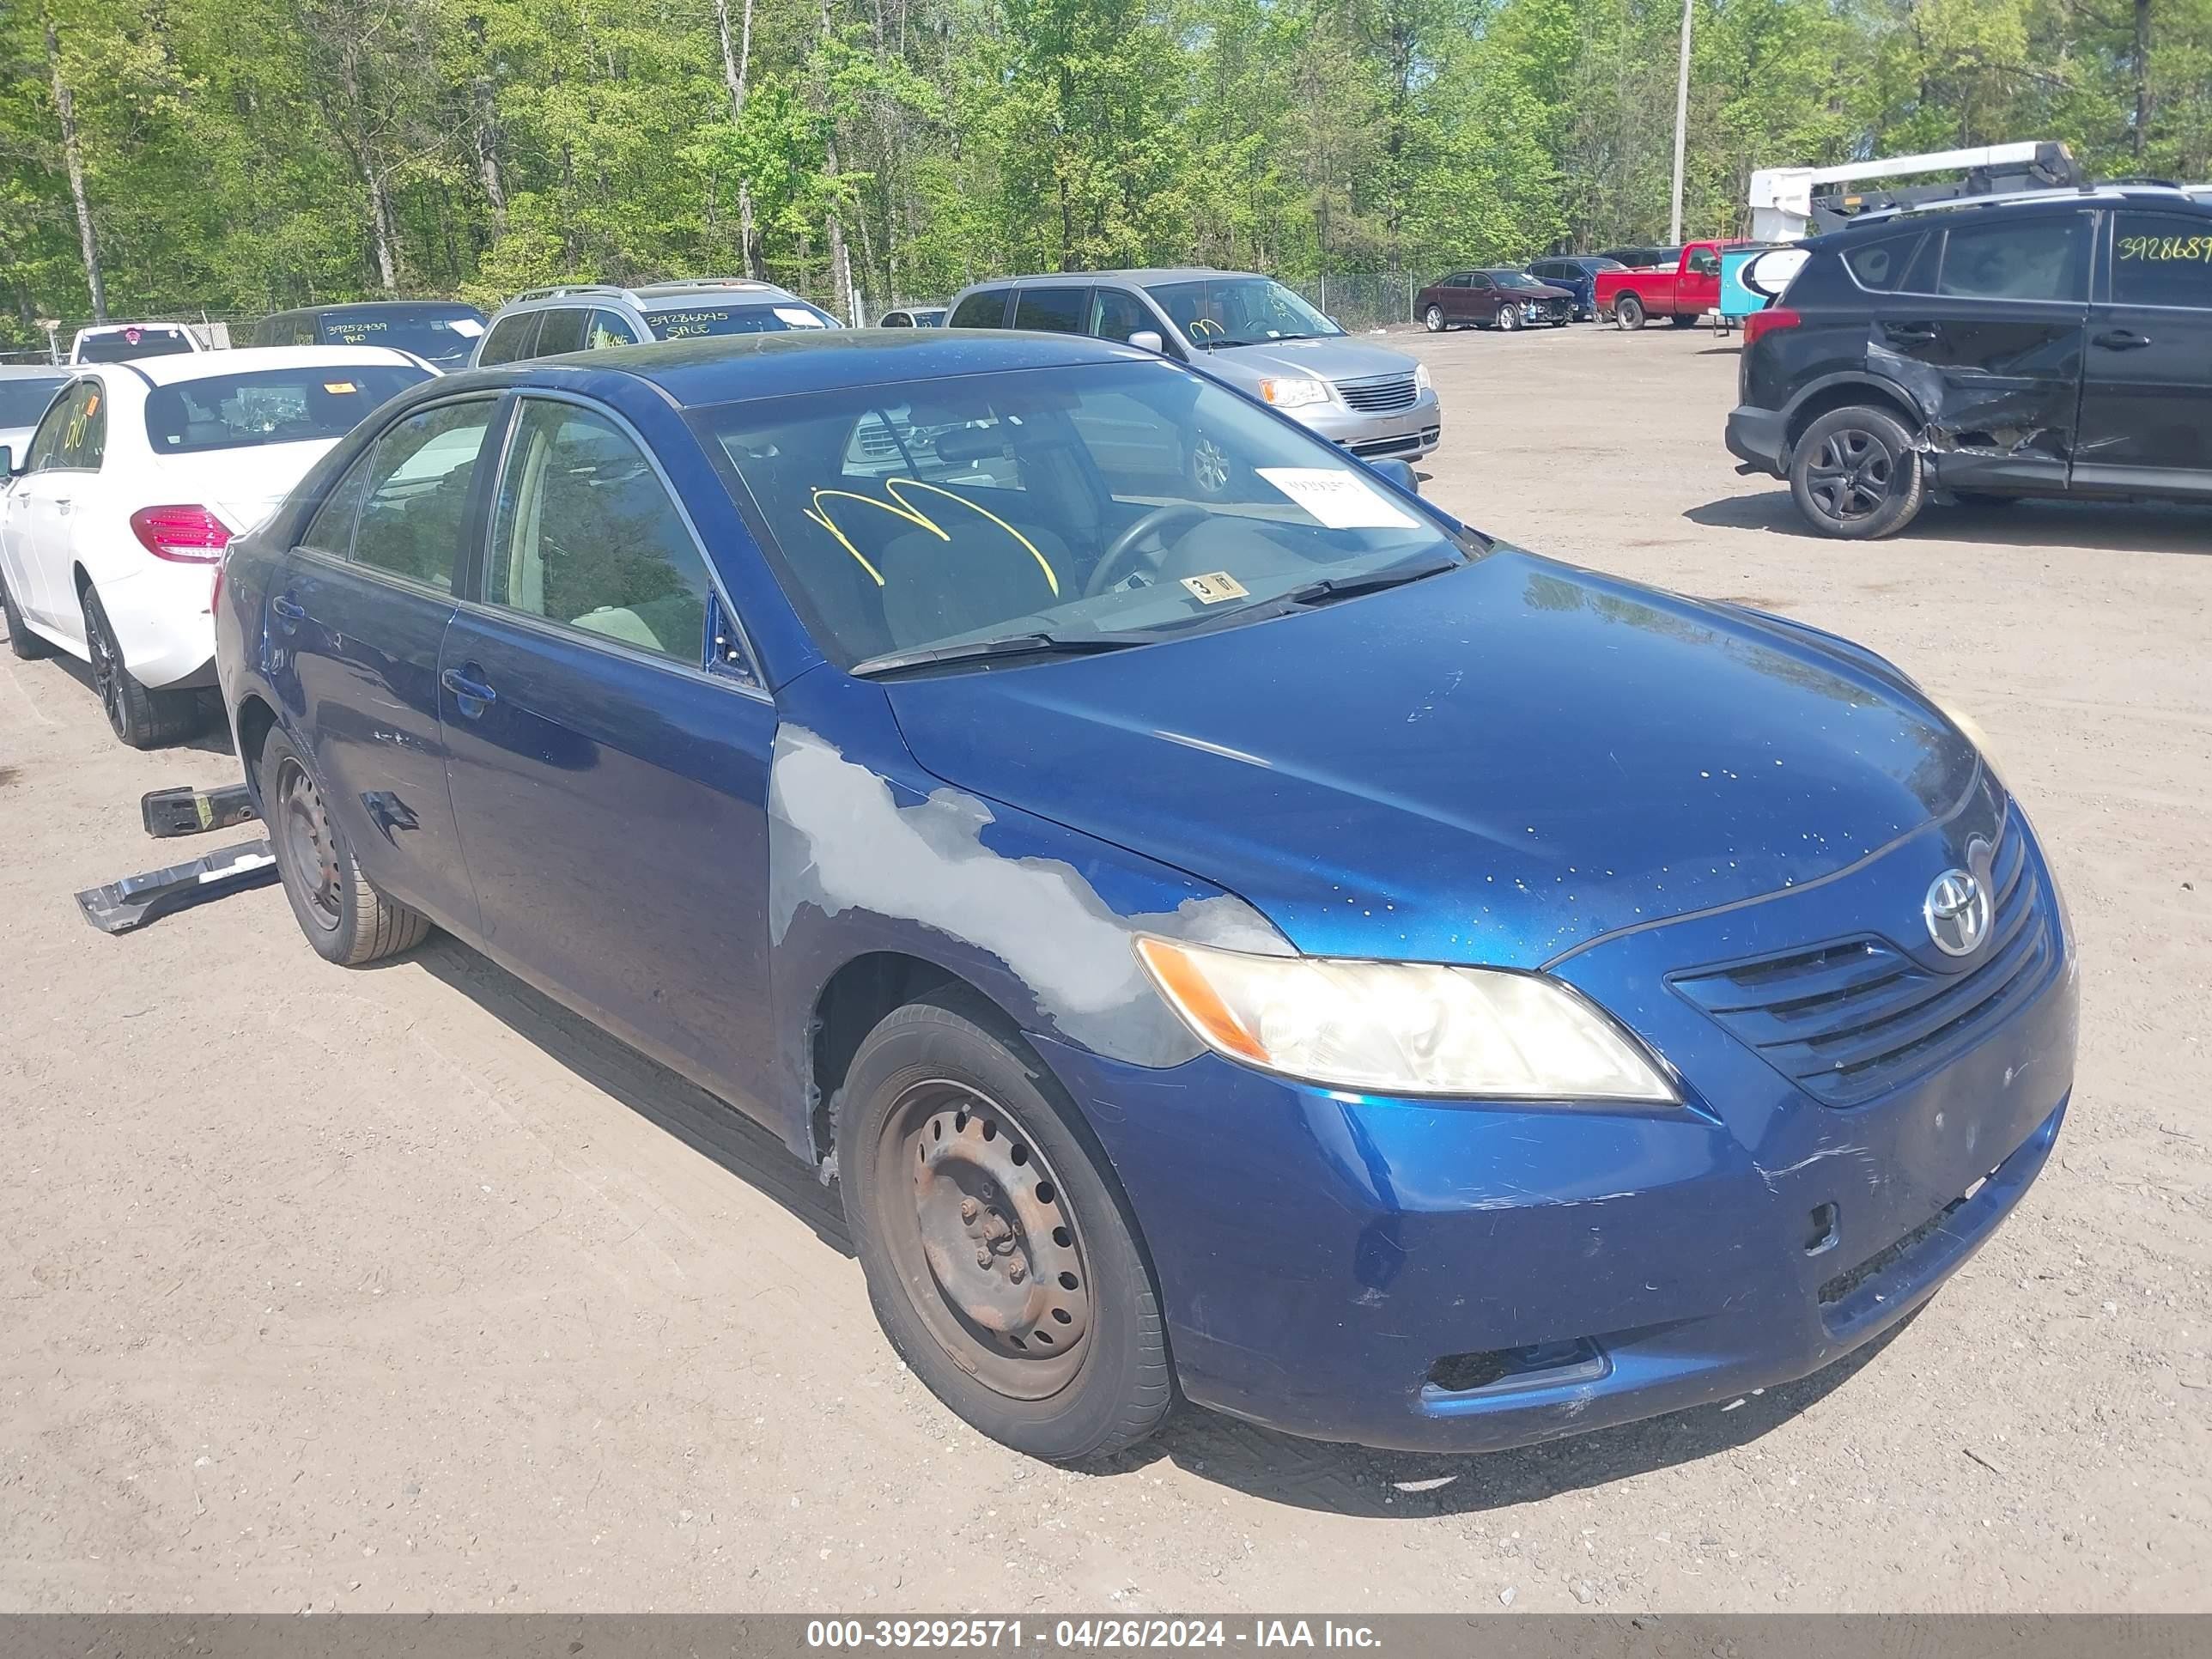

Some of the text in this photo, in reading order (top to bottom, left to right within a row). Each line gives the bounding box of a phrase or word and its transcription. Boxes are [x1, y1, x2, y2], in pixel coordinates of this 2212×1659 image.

[647, 312, 729, 326] 39286045
[665, 324, 710, 341] SALE
[1192, 580, 1212, 595] 3
